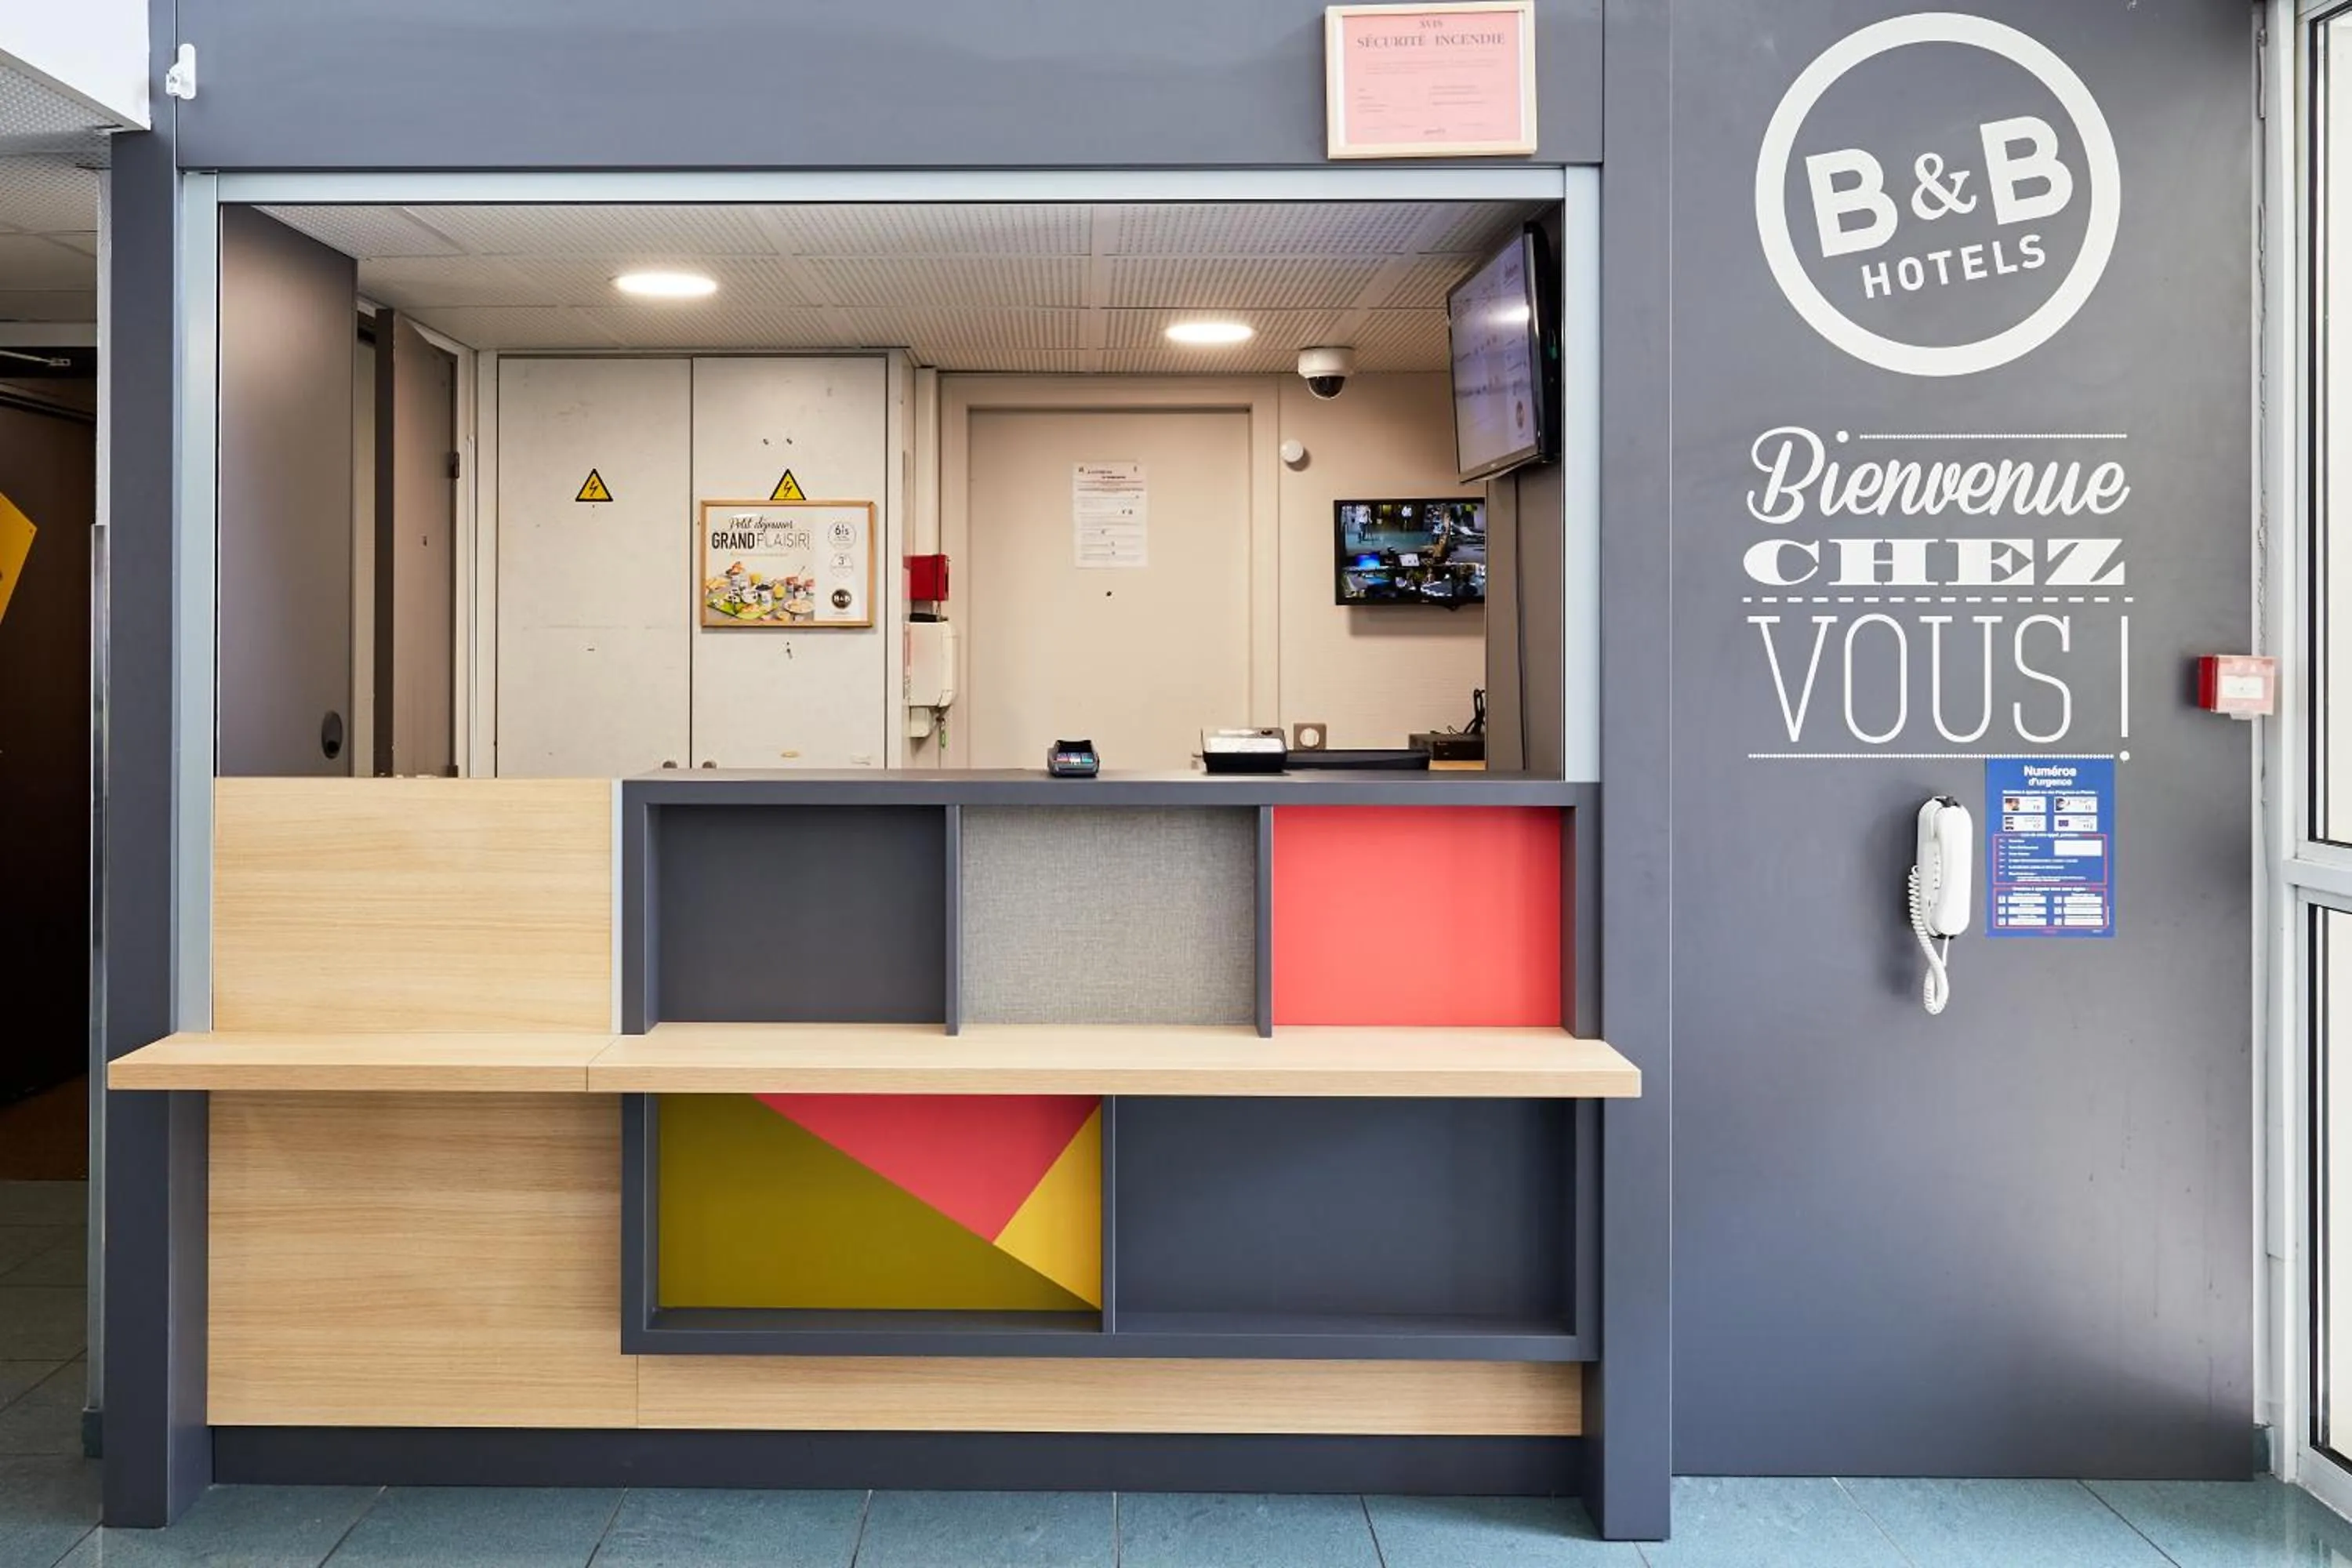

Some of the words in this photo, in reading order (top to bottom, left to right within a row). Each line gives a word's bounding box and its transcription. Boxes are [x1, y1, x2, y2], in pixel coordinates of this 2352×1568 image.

[1436, 32, 1505, 46] INCENDIE
[1806, 116, 2073, 258] B&B
[1861, 234, 2045, 299] HOTELS
[1747, 426, 2130, 524] Bienvenue
[711, 532, 755, 550] GRAND
[1743, 539, 2125, 586] CHEZ
[2024, 764, 2077, 777] Numéros
